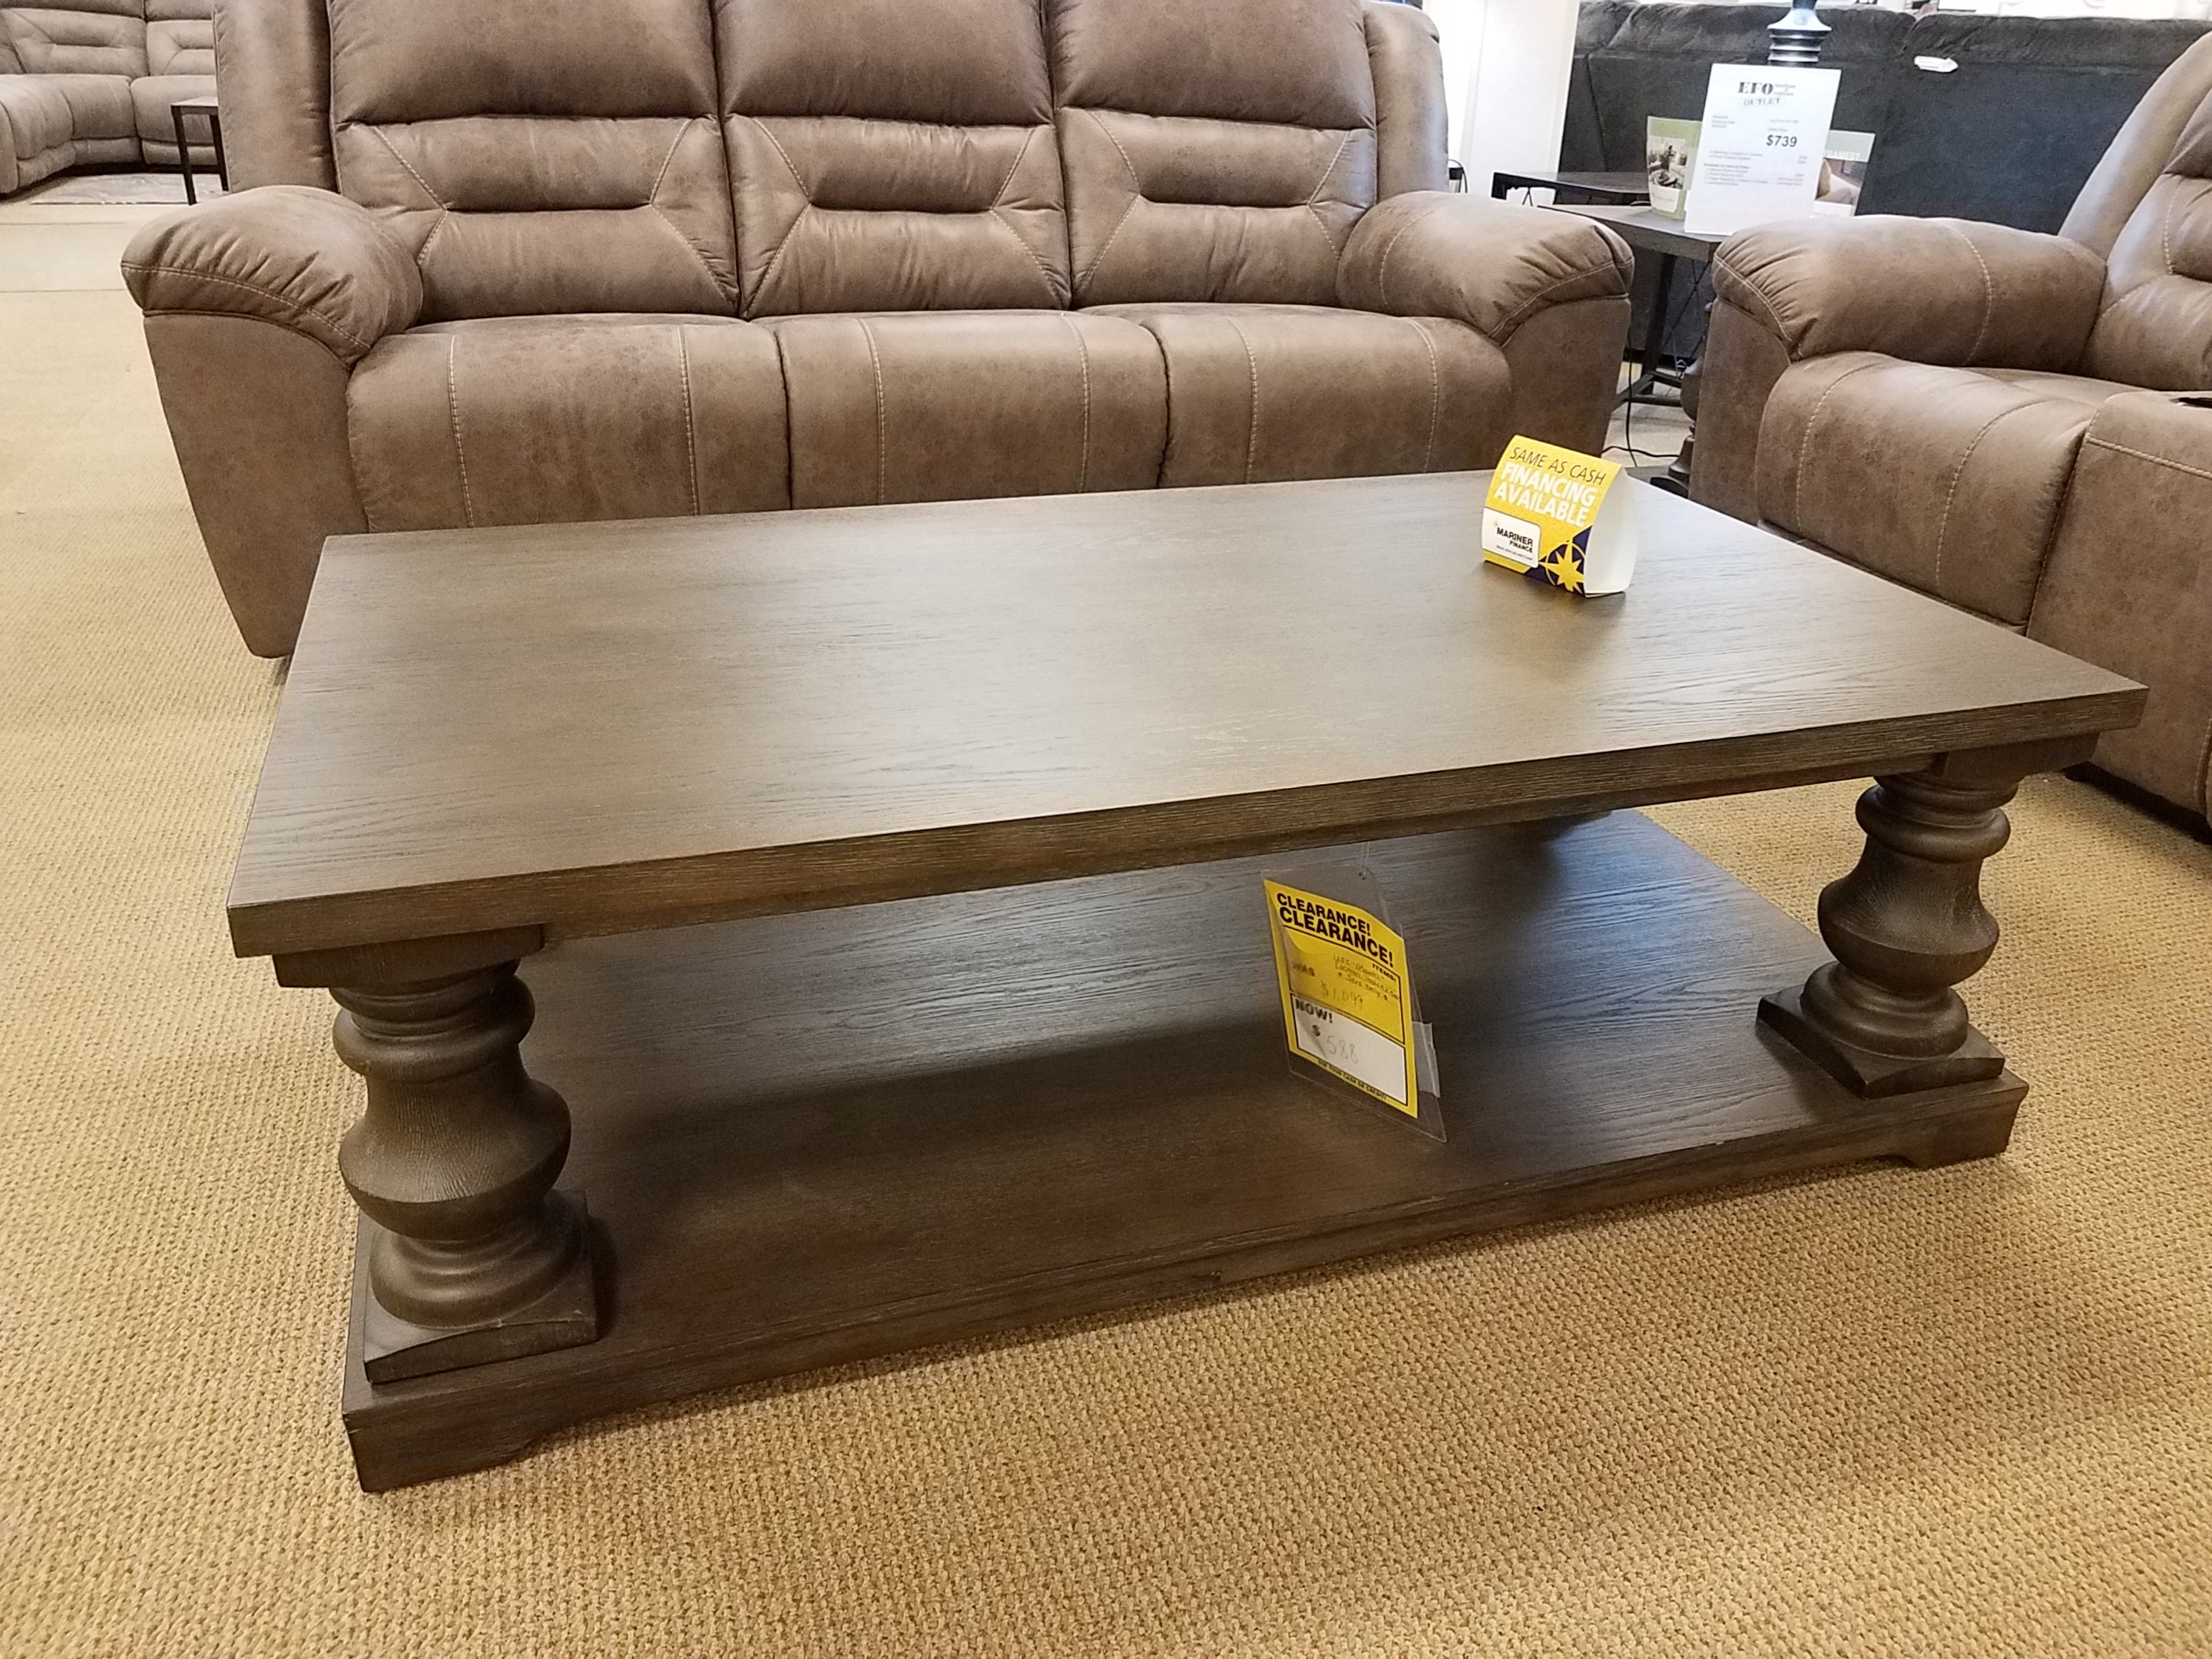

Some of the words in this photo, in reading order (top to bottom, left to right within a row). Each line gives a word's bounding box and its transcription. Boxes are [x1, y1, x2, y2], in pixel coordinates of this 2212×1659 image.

[1737, 81, 1773, 95] EFO
[1743, 98, 1780, 106] OUTLET
[1766, 134, 1797, 147] $739
[1510, 447, 1547, 468] SAME
[1548, 459, 1568, 474] AS
[1569, 465, 1607, 485] CASH
[1500, 462, 1598, 507] FINANCING
[1494, 482, 1590, 528] AVAILABLE
[1496, 527, 1533, 547] MARINER
[1277, 892, 1371, 936] CLEARANCE!
[1280, 907, 1394, 968] CLEARANCE!
[1295, 998, 1333, 1024] NOW!
